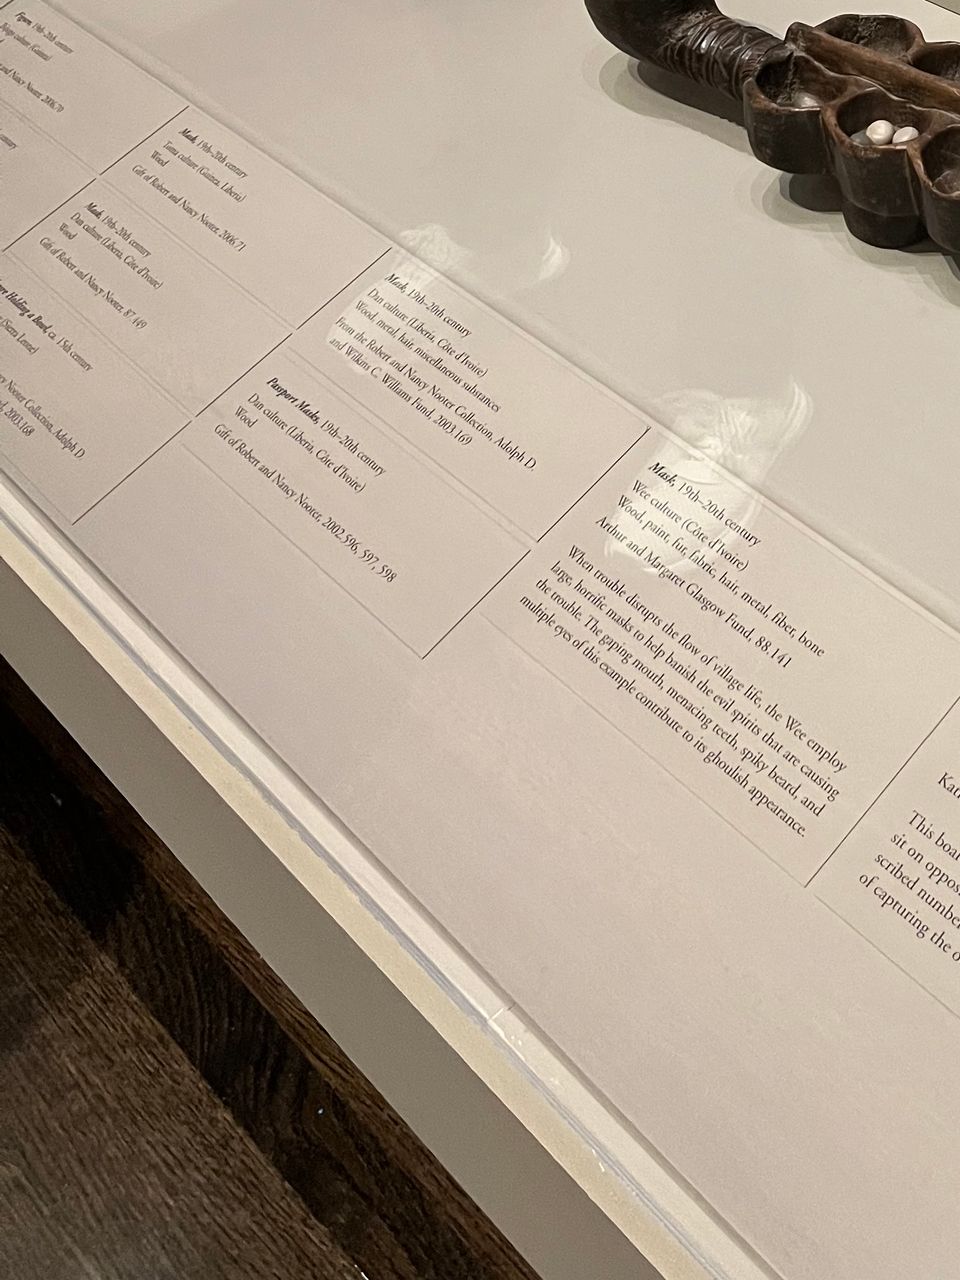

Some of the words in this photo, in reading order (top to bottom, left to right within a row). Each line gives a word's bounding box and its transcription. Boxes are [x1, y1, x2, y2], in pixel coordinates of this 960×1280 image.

[631, 478, 651, 500] Wee
[649, 497, 682, 524] culture
[679, 517, 709, 543] (Côte
[646, 461, 678, 488] Mask,
[723, 517, 762, 548] century
[594, 515, 628, 543] Arthur
[624, 540, 648, 557] and
[642, 549, 686, 588] Margaret
[685, 582, 726, 618] Glasgow
[723, 611, 756, 643] Fund,
[753, 635, 792, 668] 88.141
[617, 493, 647, 524] Wood,
[640, 519, 670, 544] paint,
[670, 536, 688, 557] fur,
[687, 548, 717, 579] fabric,
[717, 570, 740, 596] hair,
[739, 591, 773, 619] metal,
[769, 610, 797, 639] fiber,
[796, 629, 825, 657] bone
[567, 543, 594, 573] When
[592, 568, 627, 598] trouble
[624, 592, 663, 627] disrupts
[660, 621, 679, 640] the
[676, 632, 701, 656] flow
[699, 653, 719, 666] of
[712, 662, 745, 692] village
[742, 683, 763, 709] life,
[763, 702, 783, 722] the
[784, 714, 807, 741] Wee
[805, 738, 848, 774] employ
[889, 832, 907, 850] sit
[906, 846, 924, 864] on
[907, 808, 935, 840] This
[873, 853, 920, 891] scribed
[858, 873, 880, 888] of
[872, 885, 930, 939] capturing
[929, 930, 952, 953] the
